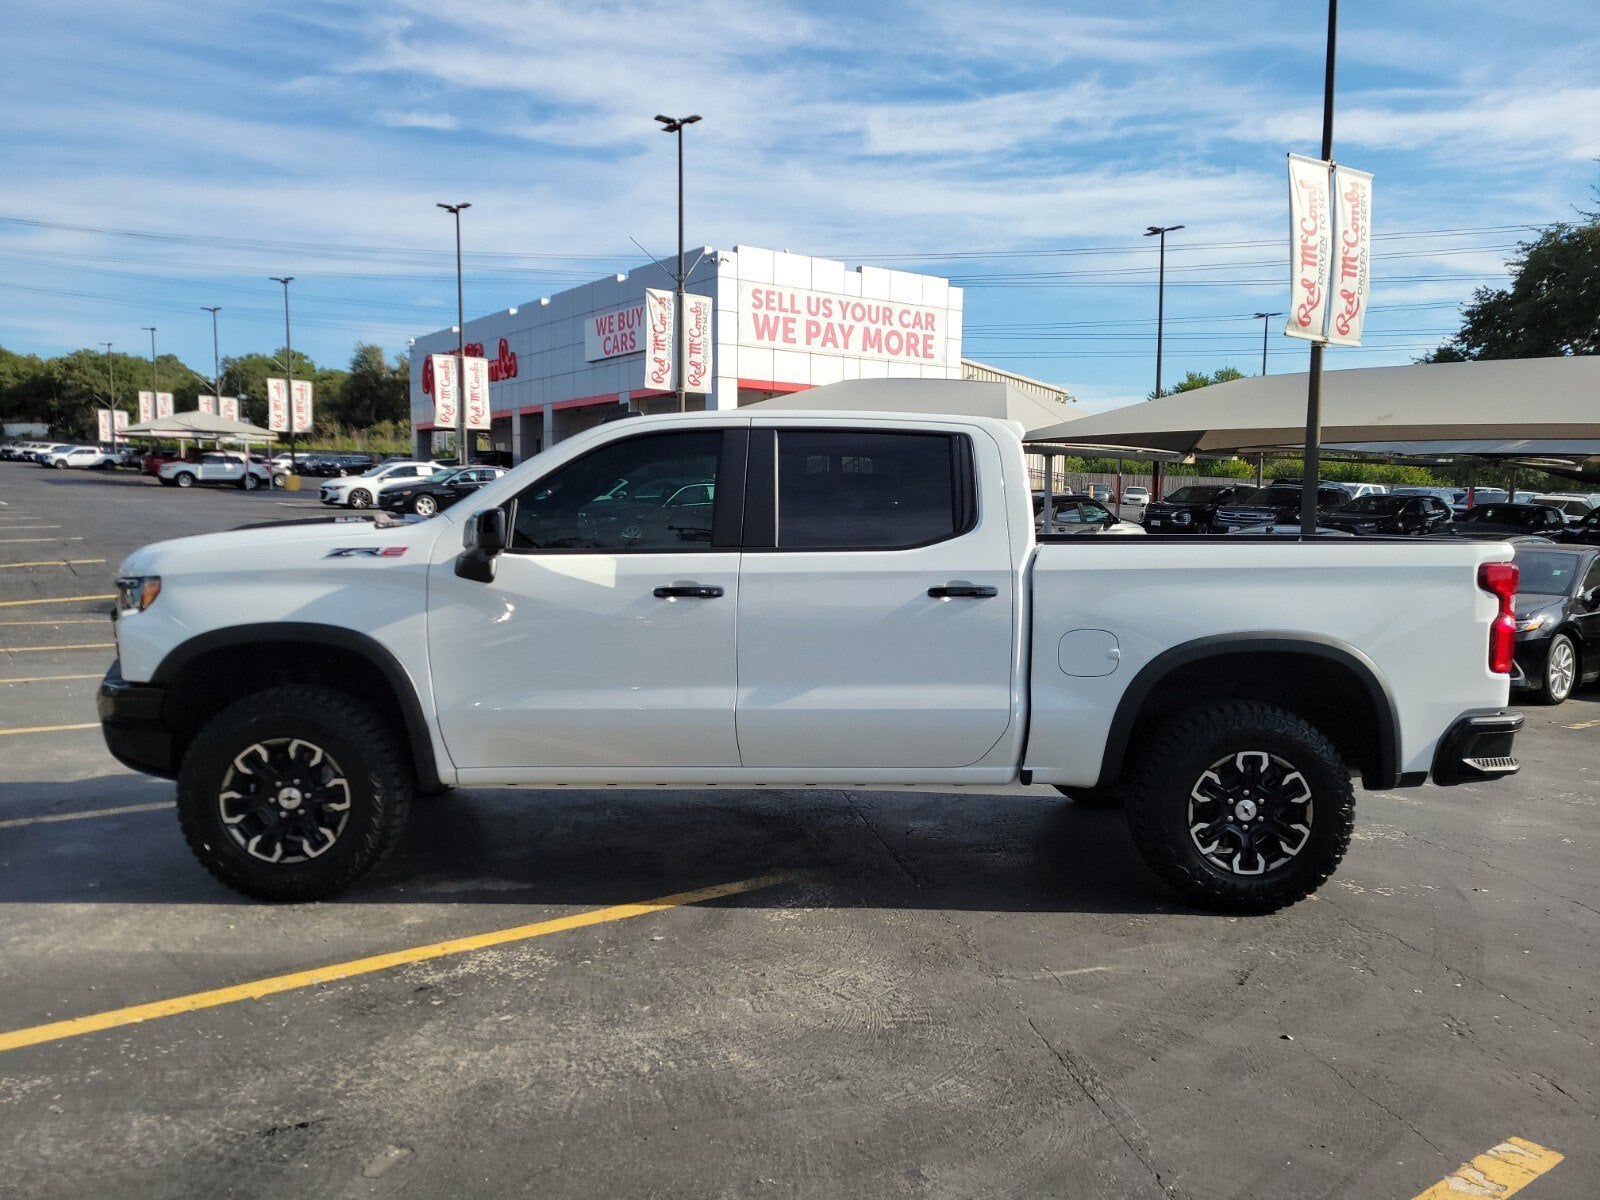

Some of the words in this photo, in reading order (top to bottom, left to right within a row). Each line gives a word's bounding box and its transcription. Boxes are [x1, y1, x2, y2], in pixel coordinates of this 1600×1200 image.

[1299, 178, 1319, 273] McCom
[1319, 212, 1326, 232] TO
[1341, 181, 1360, 284] McCombs
[1360, 225, 1367, 243] TO
[1317, 235, 1327, 286] DRIVEN
[1357, 247, 1367, 296] DRIVEN
[595, 314, 615, 337] WE
[618, 306, 644, 331] BUY
[751, 288, 801, 315] SELL
[806, 295, 833, 317] US
[837, 299, 894, 326] YOUR
[898, 308, 936, 332] CAR
[1298, 277, 1321, 328] Red
[1336, 288, 1359, 336] Red
[603, 330, 636, 355] CARS
[688, 301, 703, 359] McCombs
[752, 312, 797, 344] WE
[805, 319, 855, 350] PAY
[861, 326, 935, 360] MORE
[651, 357, 671, 384] Red
[687, 360, 707, 387] Red
